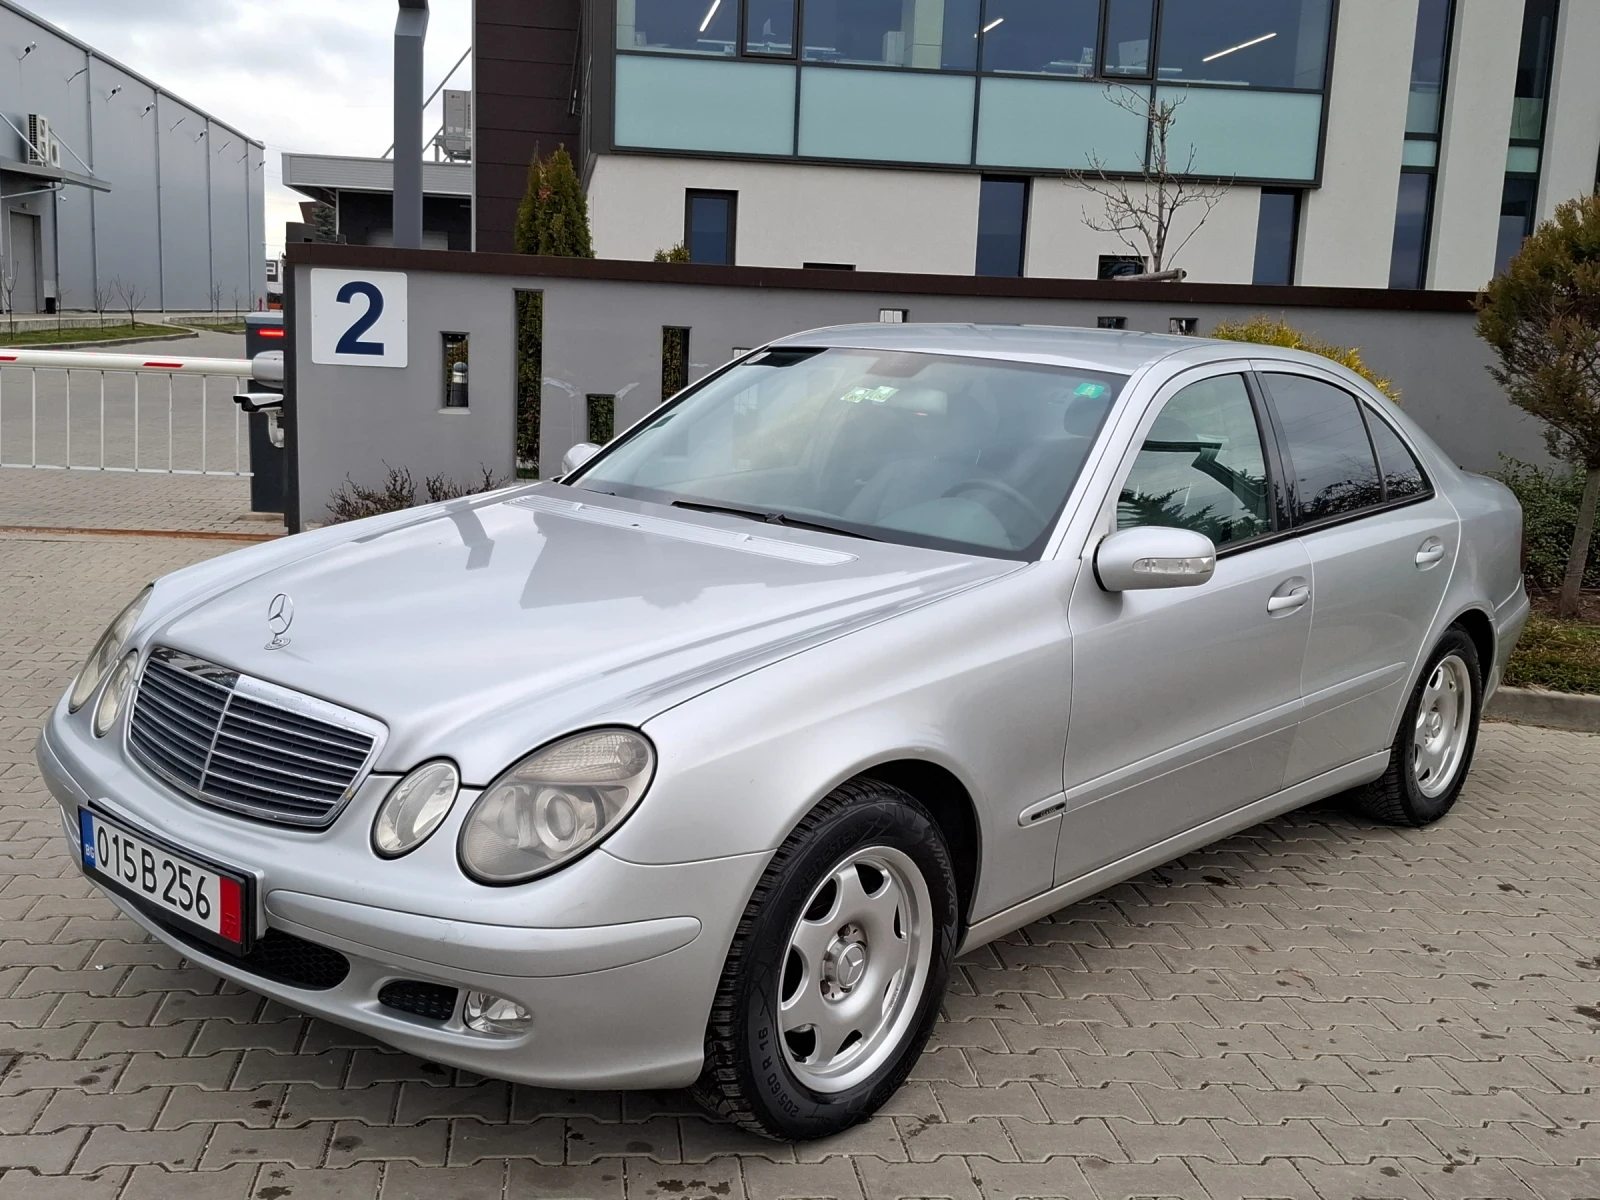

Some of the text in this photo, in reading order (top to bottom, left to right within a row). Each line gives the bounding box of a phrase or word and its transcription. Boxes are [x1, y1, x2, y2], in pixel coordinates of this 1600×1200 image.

[335, 280, 385, 356] 2
[85, 843, 95, 858] BG
[762, 1055, 773, 1071] R
[767, 1072, 800, 1118] 205/60
